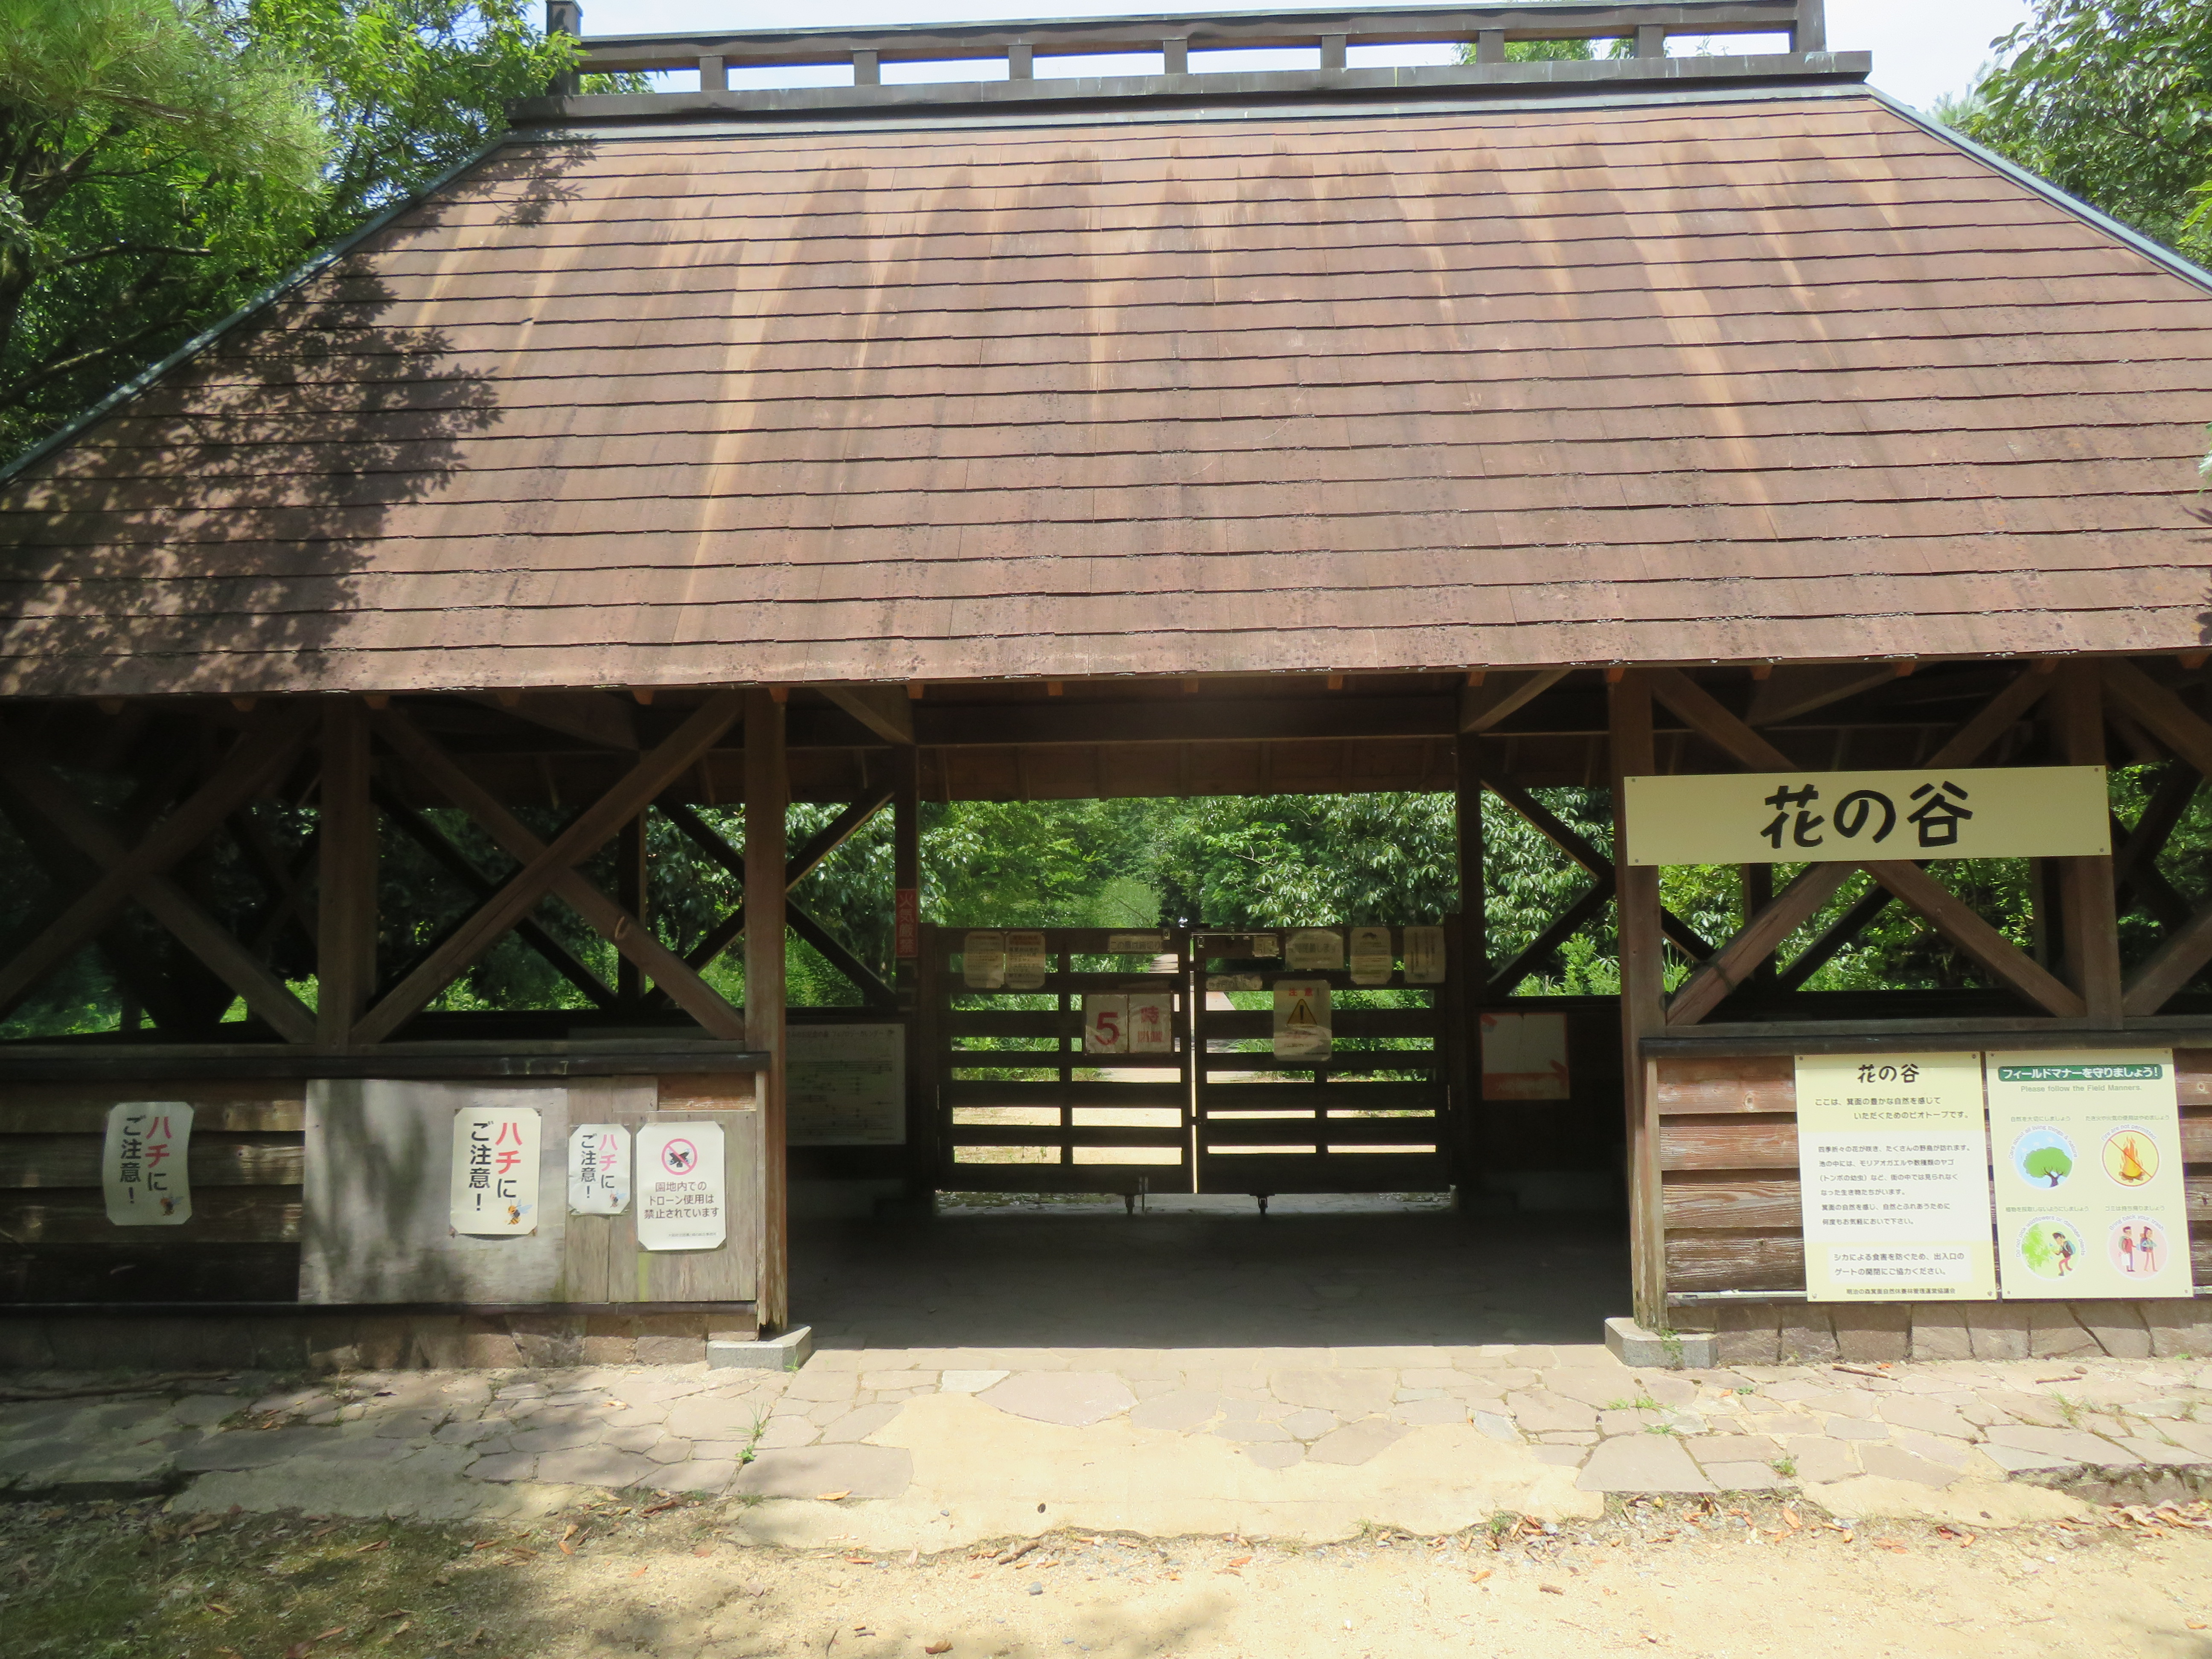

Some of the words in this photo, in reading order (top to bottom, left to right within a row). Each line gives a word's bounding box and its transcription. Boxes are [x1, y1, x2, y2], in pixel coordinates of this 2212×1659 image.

[1760, 780, 1973, 848] 花の谷
[899, 893, 914, 953] 火気厳禁
[1095, 1012, 1120, 1046] 5
[1857, 1063, 1920, 1083] 花の谷
[145, 1116, 172, 1192] ハチに
[495, 1122, 522, 1199] ハチに
[599, 1133, 618, 1189] ハチに
[649, 1194, 714, 1206] ドローン使用は
[655, 1181, 707, 1193] 園地内での
[644, 1207, 719, 1220] 禁止されています
